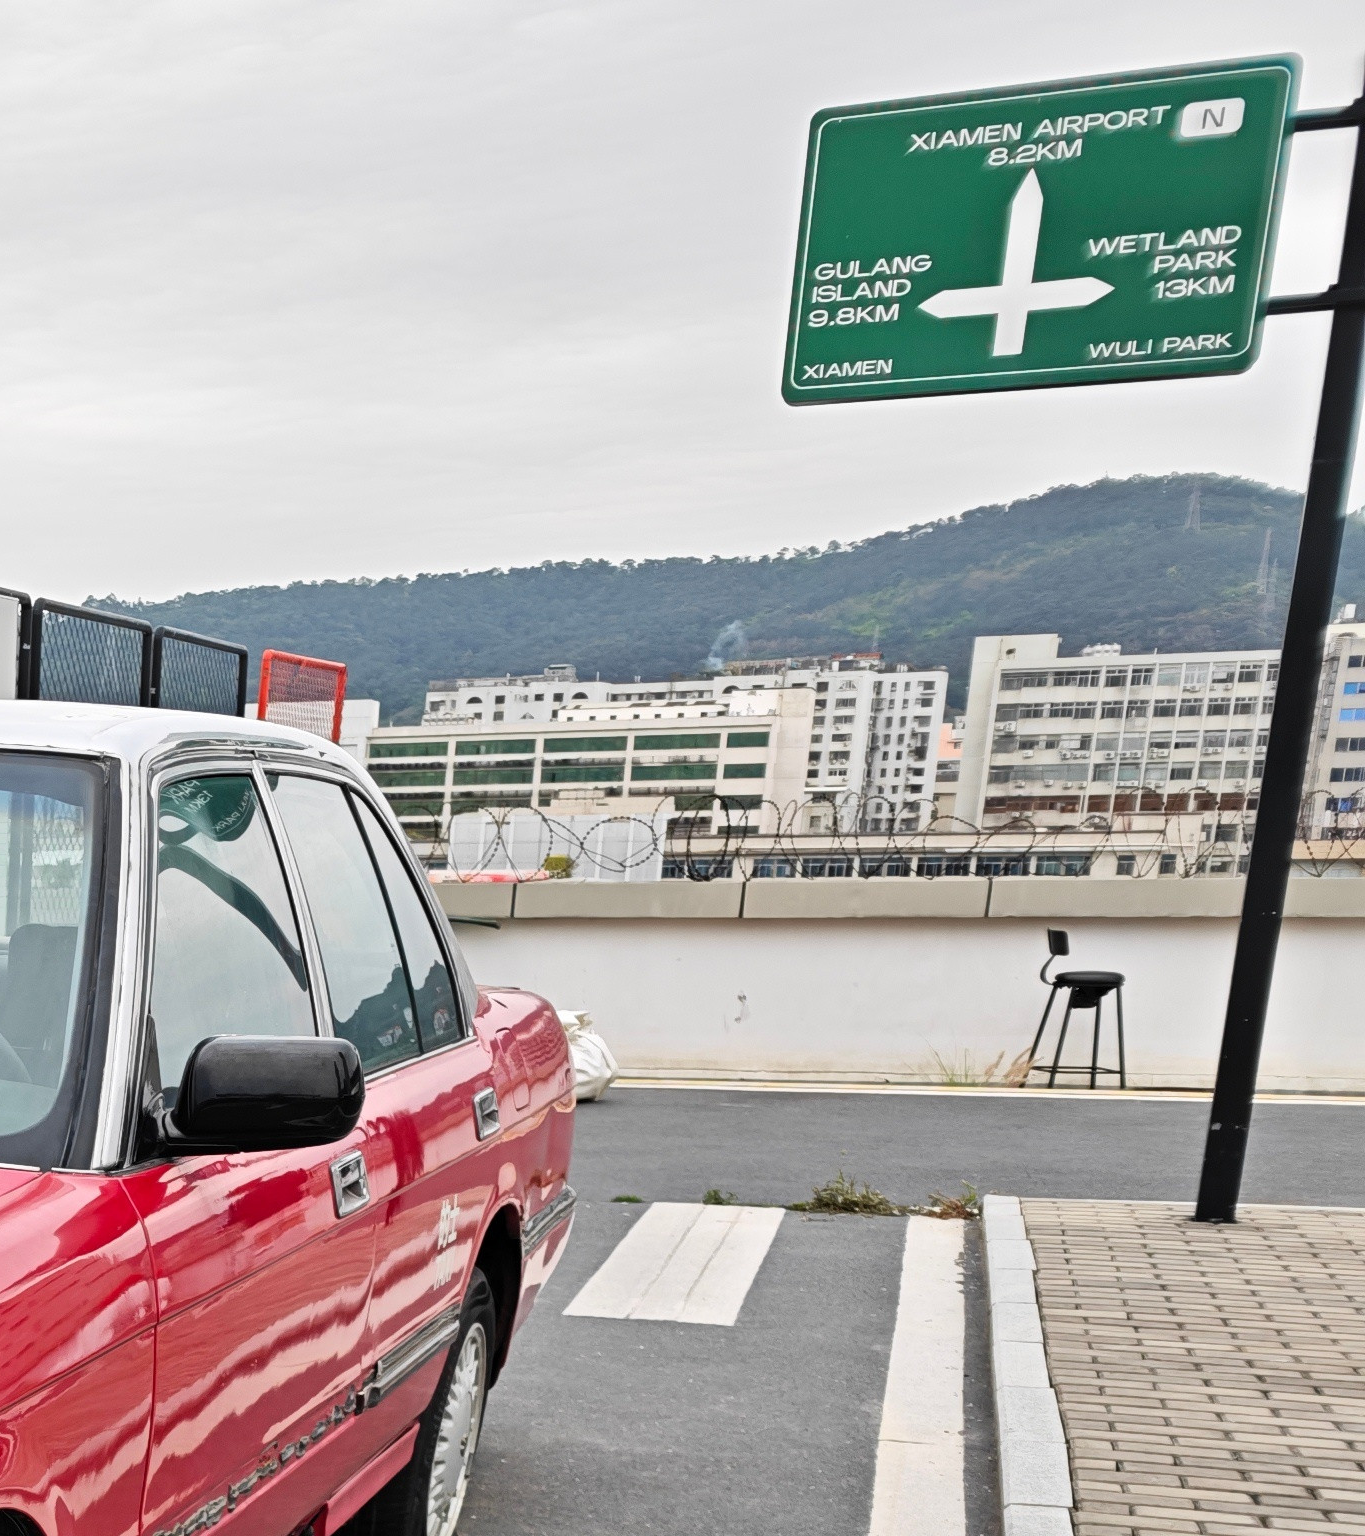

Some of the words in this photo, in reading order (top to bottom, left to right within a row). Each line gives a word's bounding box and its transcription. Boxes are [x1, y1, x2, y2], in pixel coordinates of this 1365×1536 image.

[907, 121, 1022, 153] XIAMEN
[1033, 105, 1171, 139] AIRPORT
[1202, 107, 1227, 129] N
[988, 139, 1083, 166] 8.2KM
[1089, 225, 1242, 257] WETLAND
[814, 254, 933, 281] GULANG
[1152, 248, 1237, 274] PARK
[811, 278, 912, 304] ISLAND
[1155, 274, 1236, 299] 13KM
[808, 303, 900, 328] 9.8KM
[1089, 338, 1153, 359] WULI
[1162, 332, 1234, 353] PARK
[800, 358, 893, 380] XIAMEN
